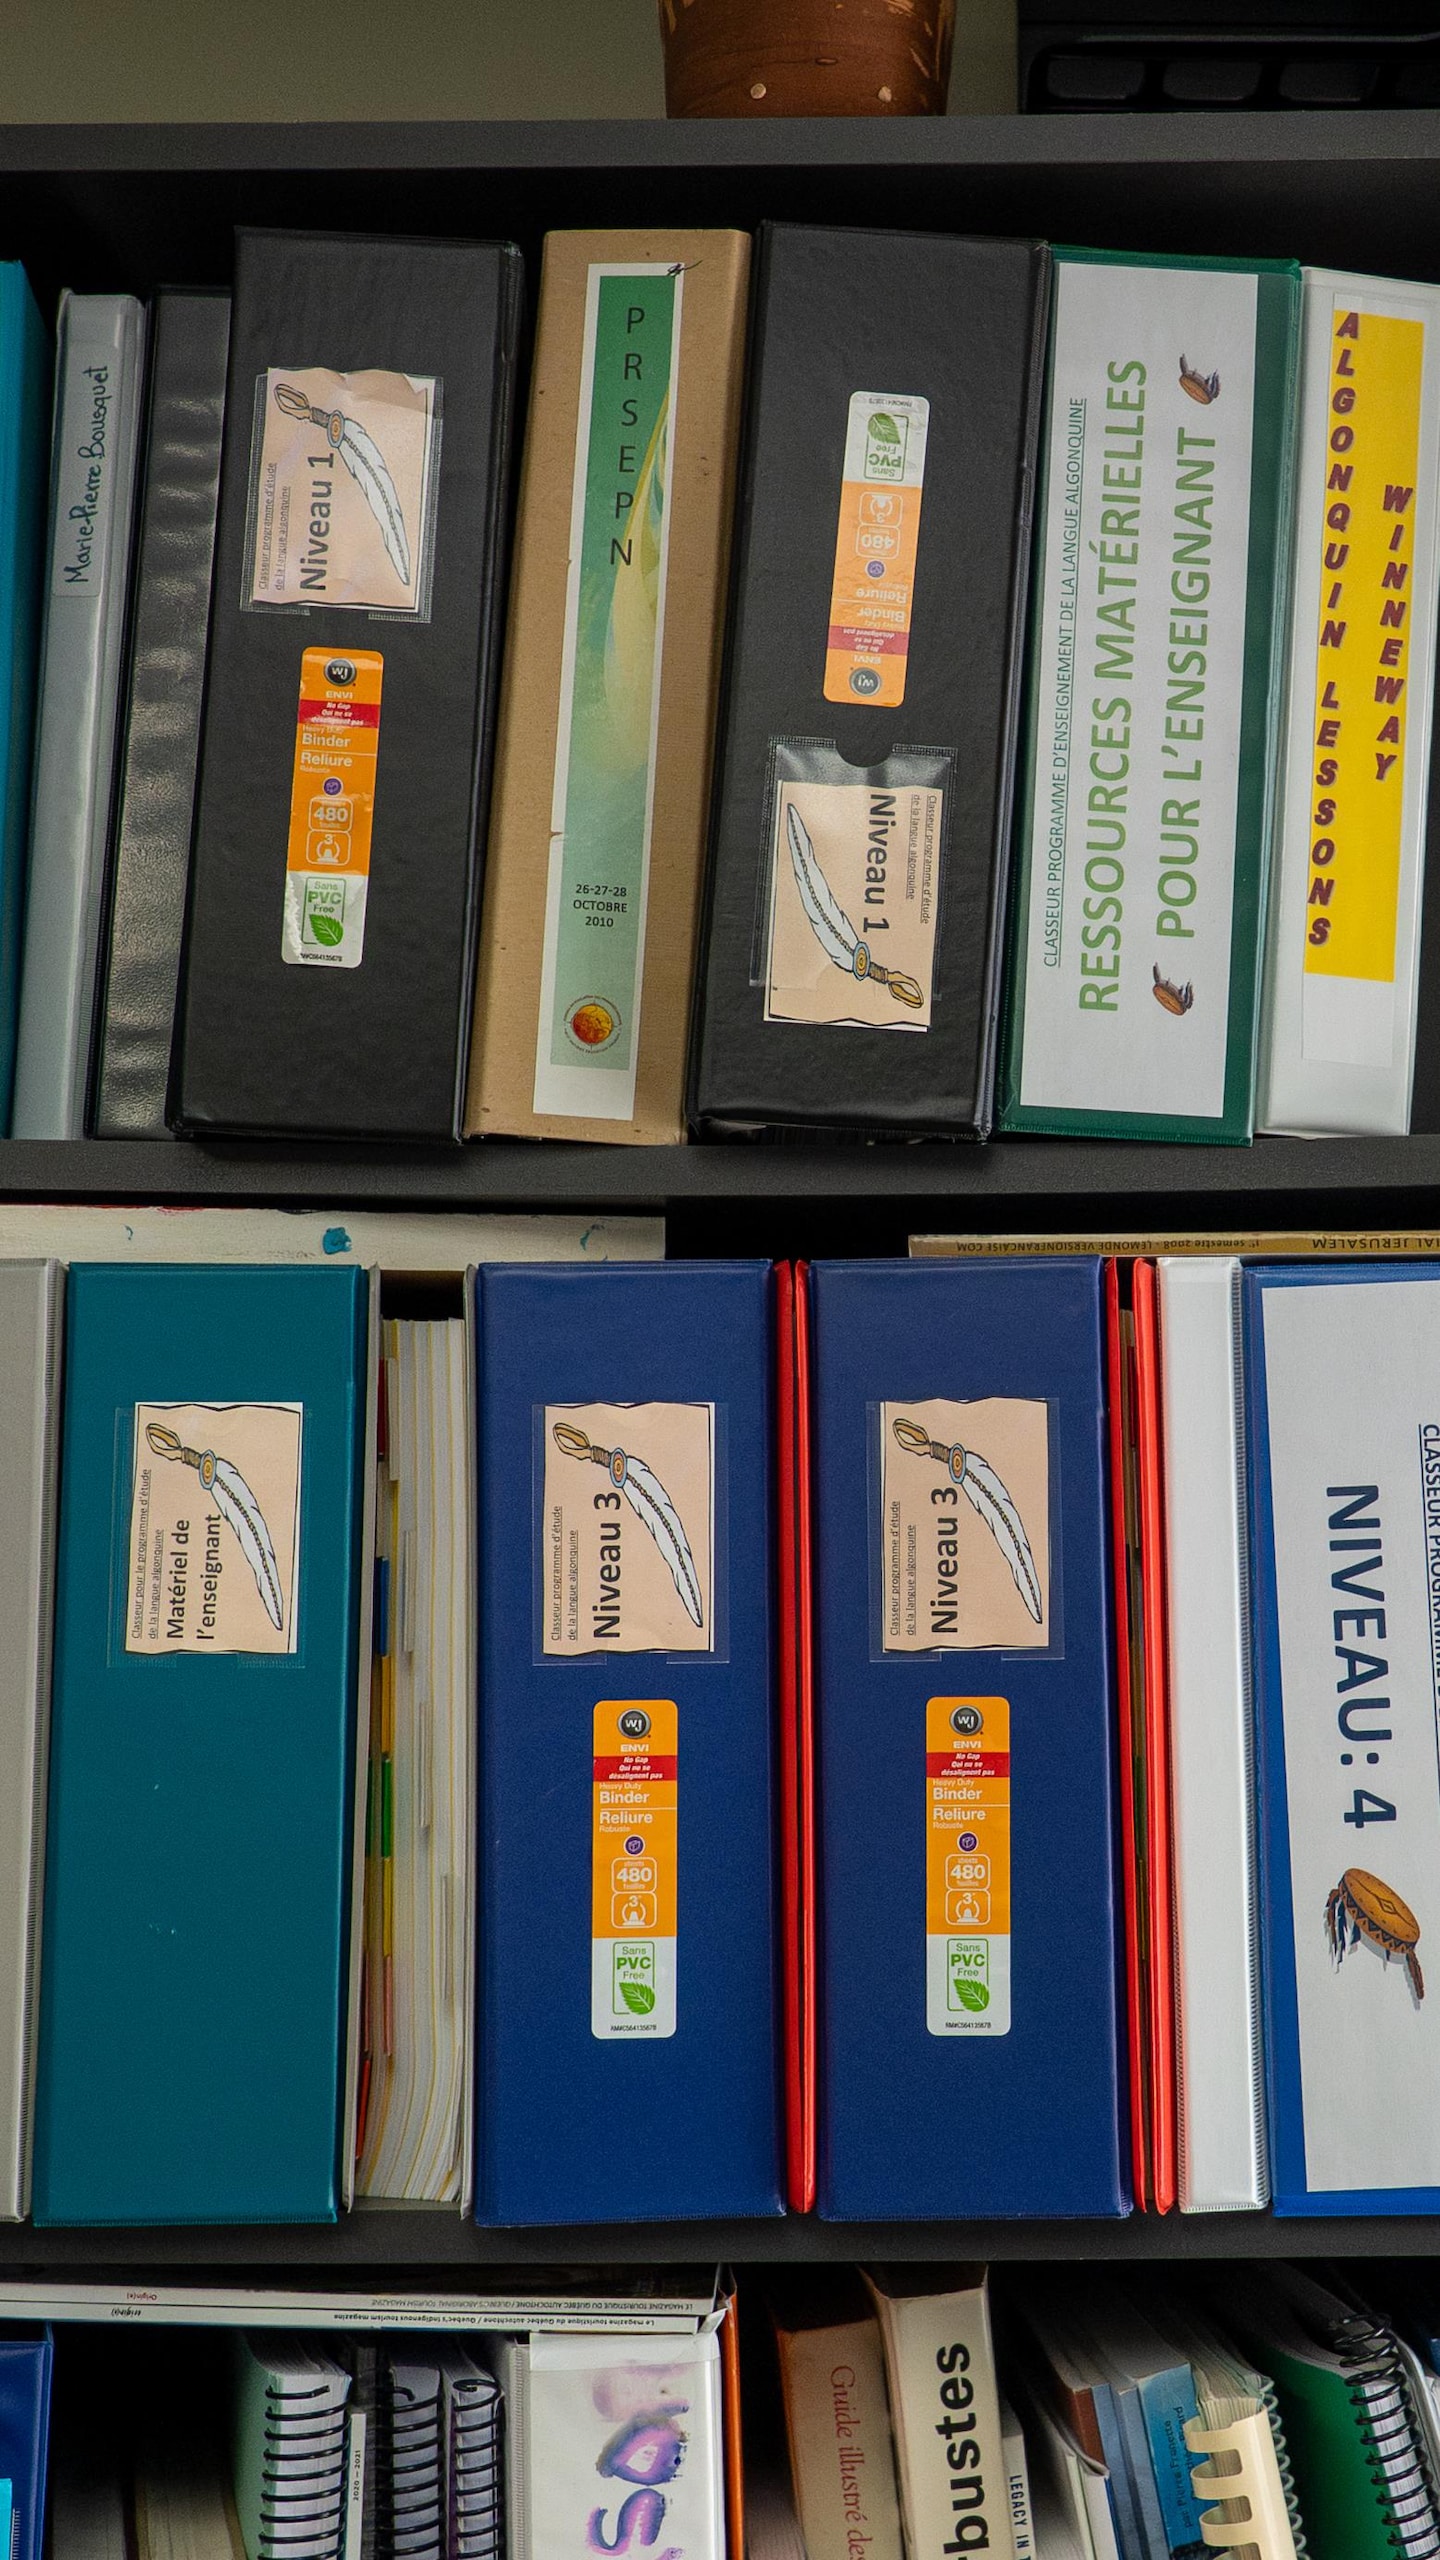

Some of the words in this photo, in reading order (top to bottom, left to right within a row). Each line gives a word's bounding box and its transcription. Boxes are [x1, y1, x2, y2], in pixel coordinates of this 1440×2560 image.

[78, 365, 112, 459] Bousquet
[869, 454, 902, 466] PVC
[876, 445, 896, 454] Free
[1064, 399, 1086, 504] ALGONQUINE
[308, 454, 334, 468] 1
[872, 467, 895, 477] Sans
[1320, 312, 1359, 649] ALGONQUIN
[64, 465, 101, 583] Marie-Pierre
[1089, 360, 1147, 679] MATÉRIELLES
[300, 481, 332, 590] Niveau
[861, 534, 895, 549] 480
[1060, 509, 1080, 572] LANGUE
[856, 588, 907, 603] Reliure
[1059, 576, 1076, 597] LA
[858, 607, 905, 622] Binder
[1059, 600, 1075, 621] DE
[1163, 428, 1214, 781] L'ENSEIGNANT
[1374, 485, 1413, 782] WINNEWAY
[1051, 624, 1075, 768] D'ENSEIGNEMENT
[302, 733, 350, 748] Binder
[301, 752, 352, 766] Reliure
[314, 807, 348, 822] 480
[926, 794, 937, 833] Classeur
[1307, 682, 1339, 944] LESSONS
[1047, 773, 1067, 882] PROGRAMME
[865, 794, 896, 904] Niveau
[1078, 697, 1131, 1012] RESSOURCES
[922, 835, 934, 888] programme
[1157, 799, 1200, 938] POUR
[314, 881, 337, 890] Sans
[575, 884, 627, 897] 26-27-28
[309, 891, 342, 903] PVC
[573, 900, 627, 913] OCTOBRE
[314, 904, 334, 913] Free
[585, 916, 613, 927] 2010
[864, 917, 890, 933] 1
[1043, 887, 1063, 967] CLASSEUR
[1163, 1239, 1191, 1247] 2008
[1195, 1239, 1245, 1247] semestre
[1312, 1237, 1409, 1248] JERUSALEM
[139, 1469, 150, 1506] d'étude
[931, 1488, 958, 1505] 3
[593, 1493, 620, 1510] 3
[551, 1506, 562, 1542] d'étude
[890, 1501, 900, 1537] d'étude
[137, 1508, 148, 1562] programme
[170, 1520, 189, 1544] de
[152, 1529, 163, 1581] algonquine
[568, 1530, 578, 1583] algonquine
[906, 1525, 916, 1577] algonquine
[197, 1514, 222, 1640] l'enseignant
[552, 1545, 562, 1600] programme
[890, 1539, 900, 1594] programme
[931, 1518, 958, 1633] Niveau
[135, 1576, 144, 1598] pour
[593, 1523, 621, 1638] Niveau
[149, 1583, 161, 1615] langue
[167, 1551, 187, 1638] Matériel
[568, 1584, 577, 1616] langue
[906, 1579, 915, 1611] langue
[132, 1601, 143, 1639] Classeur
[551, 1603, 561, 1641] Classeur
[568, 1618, 577, 1626] la
[890, 1597, 900, 1636] Classeur
[905, 1613, 915, 1621] la
[1326, 1485, 1393, 1765] NIVEAU:
[148, 1627, 158, 1639] de
[568, 1628, 577, 1641] de
[906, 1624, 915, 1636] de
[620, 1744, 649, 1752] ENVI
[953, 1741, 982, 1749] ENVI
[635, 1757, 648, 1765] Gap
[966, 1753, 980, 1761] Gap
[599, 1791, 649, 1804] Binder
[933, 1787, 982, 1800] Binder
[600, 1812, 653, 1825] Reliure
[933, 1808, 985, 1821] Reliure
[1344, 1789, 1397, 1828] 4
[617, 1868, 652, 1883] 480
[950, 1865, 985, 1880] 480
[622, 1946, 646, 1955] Sans
[956, 1943, 980, 1952] Sans
[617, 1958, 651, 1970] PVC
[950, 1954, 985, 1966] PVC
[623, 1971, 644, 1979] Free
[957, 1968, 978, 1976] Free
[830, 2366, 860, 2438] Guide
[937, 2341, 990, 2560] bustes
[838, 2446, 868, 2521] illustré
[1010, 2475, 1027, 2525] LEGACY
[1016, 2535, 1029, 2549] IN
